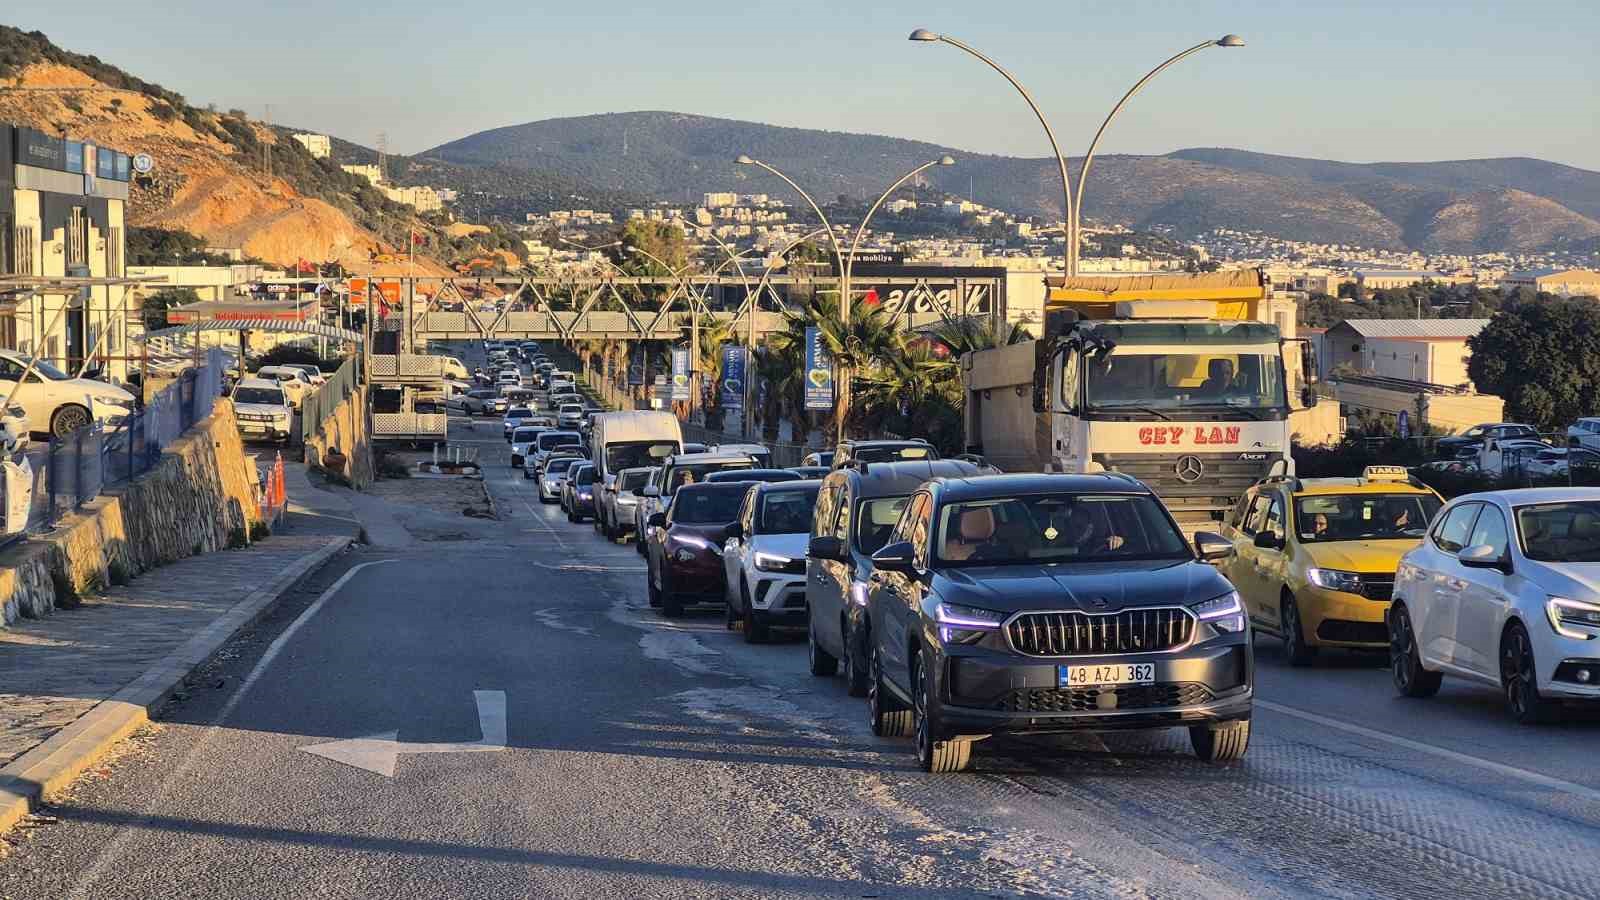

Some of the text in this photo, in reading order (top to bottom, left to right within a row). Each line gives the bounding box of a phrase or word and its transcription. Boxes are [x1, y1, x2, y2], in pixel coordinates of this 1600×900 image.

[1138, 426, 1240, 444] CEY LAN
[1070, 665, 1153, 683] 48 AZJ 362
